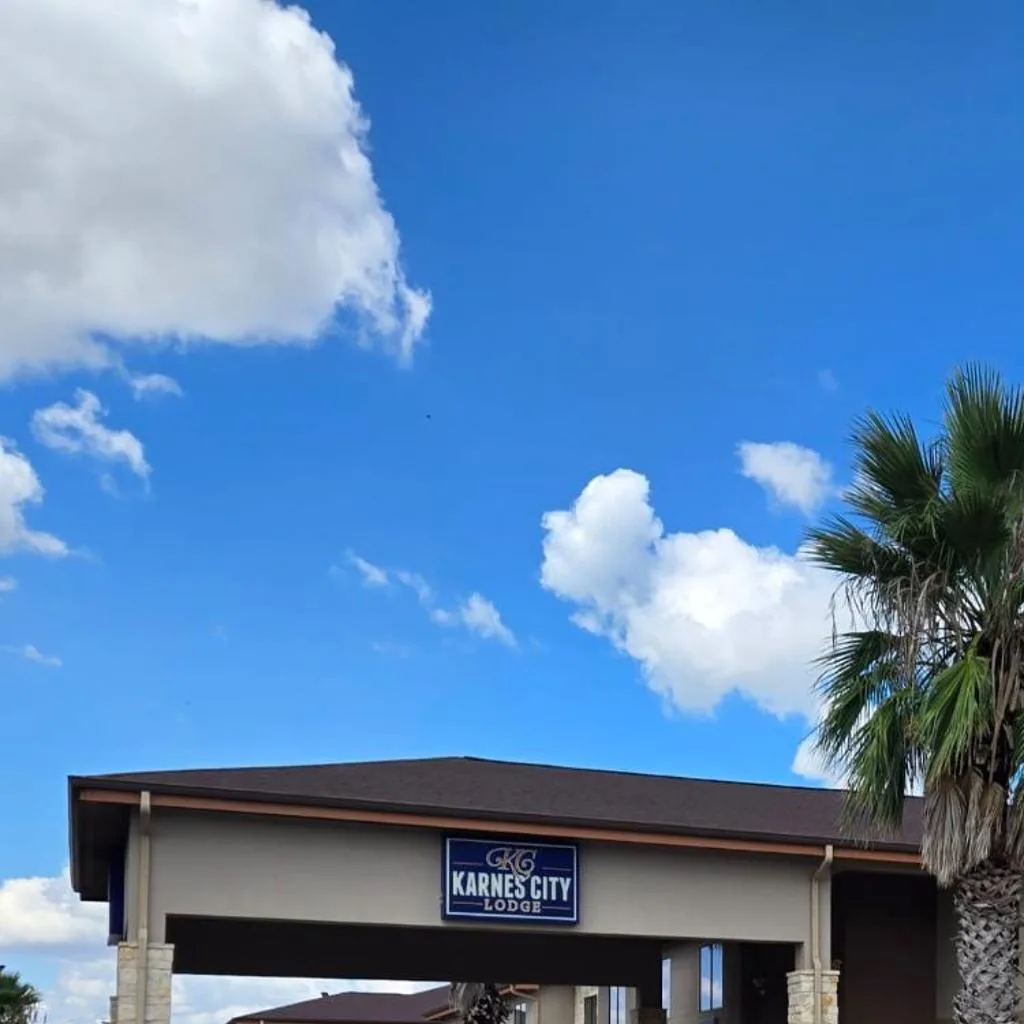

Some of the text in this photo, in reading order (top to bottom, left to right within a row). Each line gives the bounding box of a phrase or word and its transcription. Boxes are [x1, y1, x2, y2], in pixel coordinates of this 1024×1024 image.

[452, 870, 572, 902] KARNES CITY
[484, 898, 542, 913] LODGE
